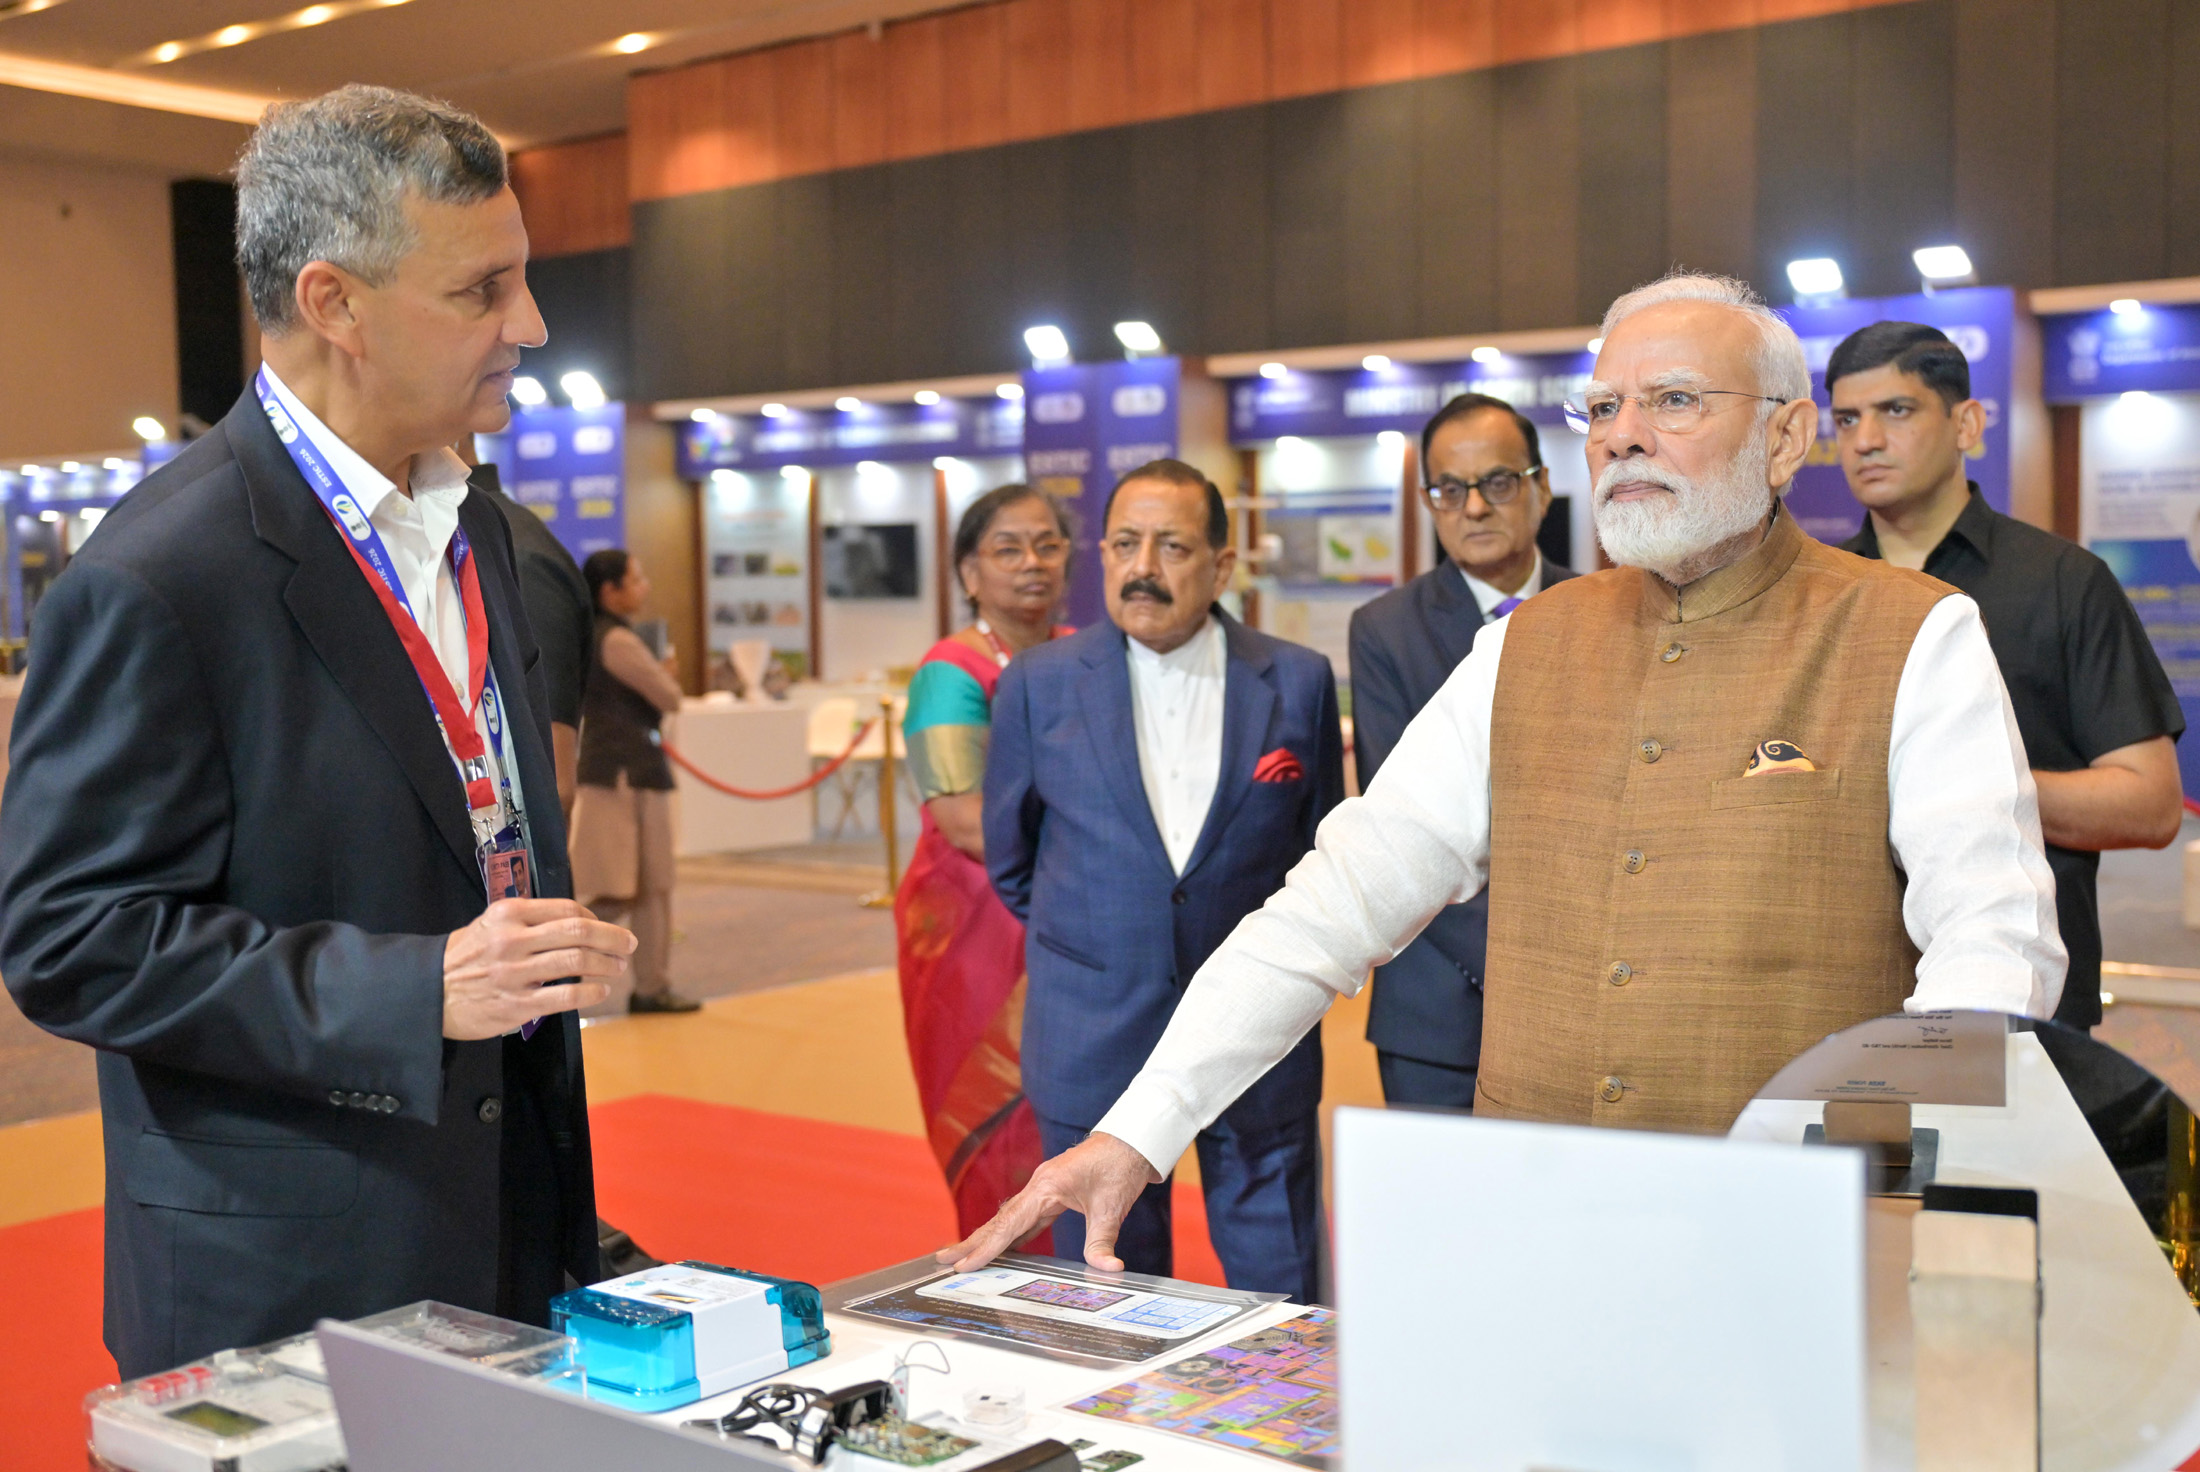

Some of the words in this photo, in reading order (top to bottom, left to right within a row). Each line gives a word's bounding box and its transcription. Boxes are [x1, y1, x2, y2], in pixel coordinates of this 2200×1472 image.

[300, 448, 316, 467] 2026
[312, 464, 333, 488] ESTIC
[367, 547, 382, 567] 2026
